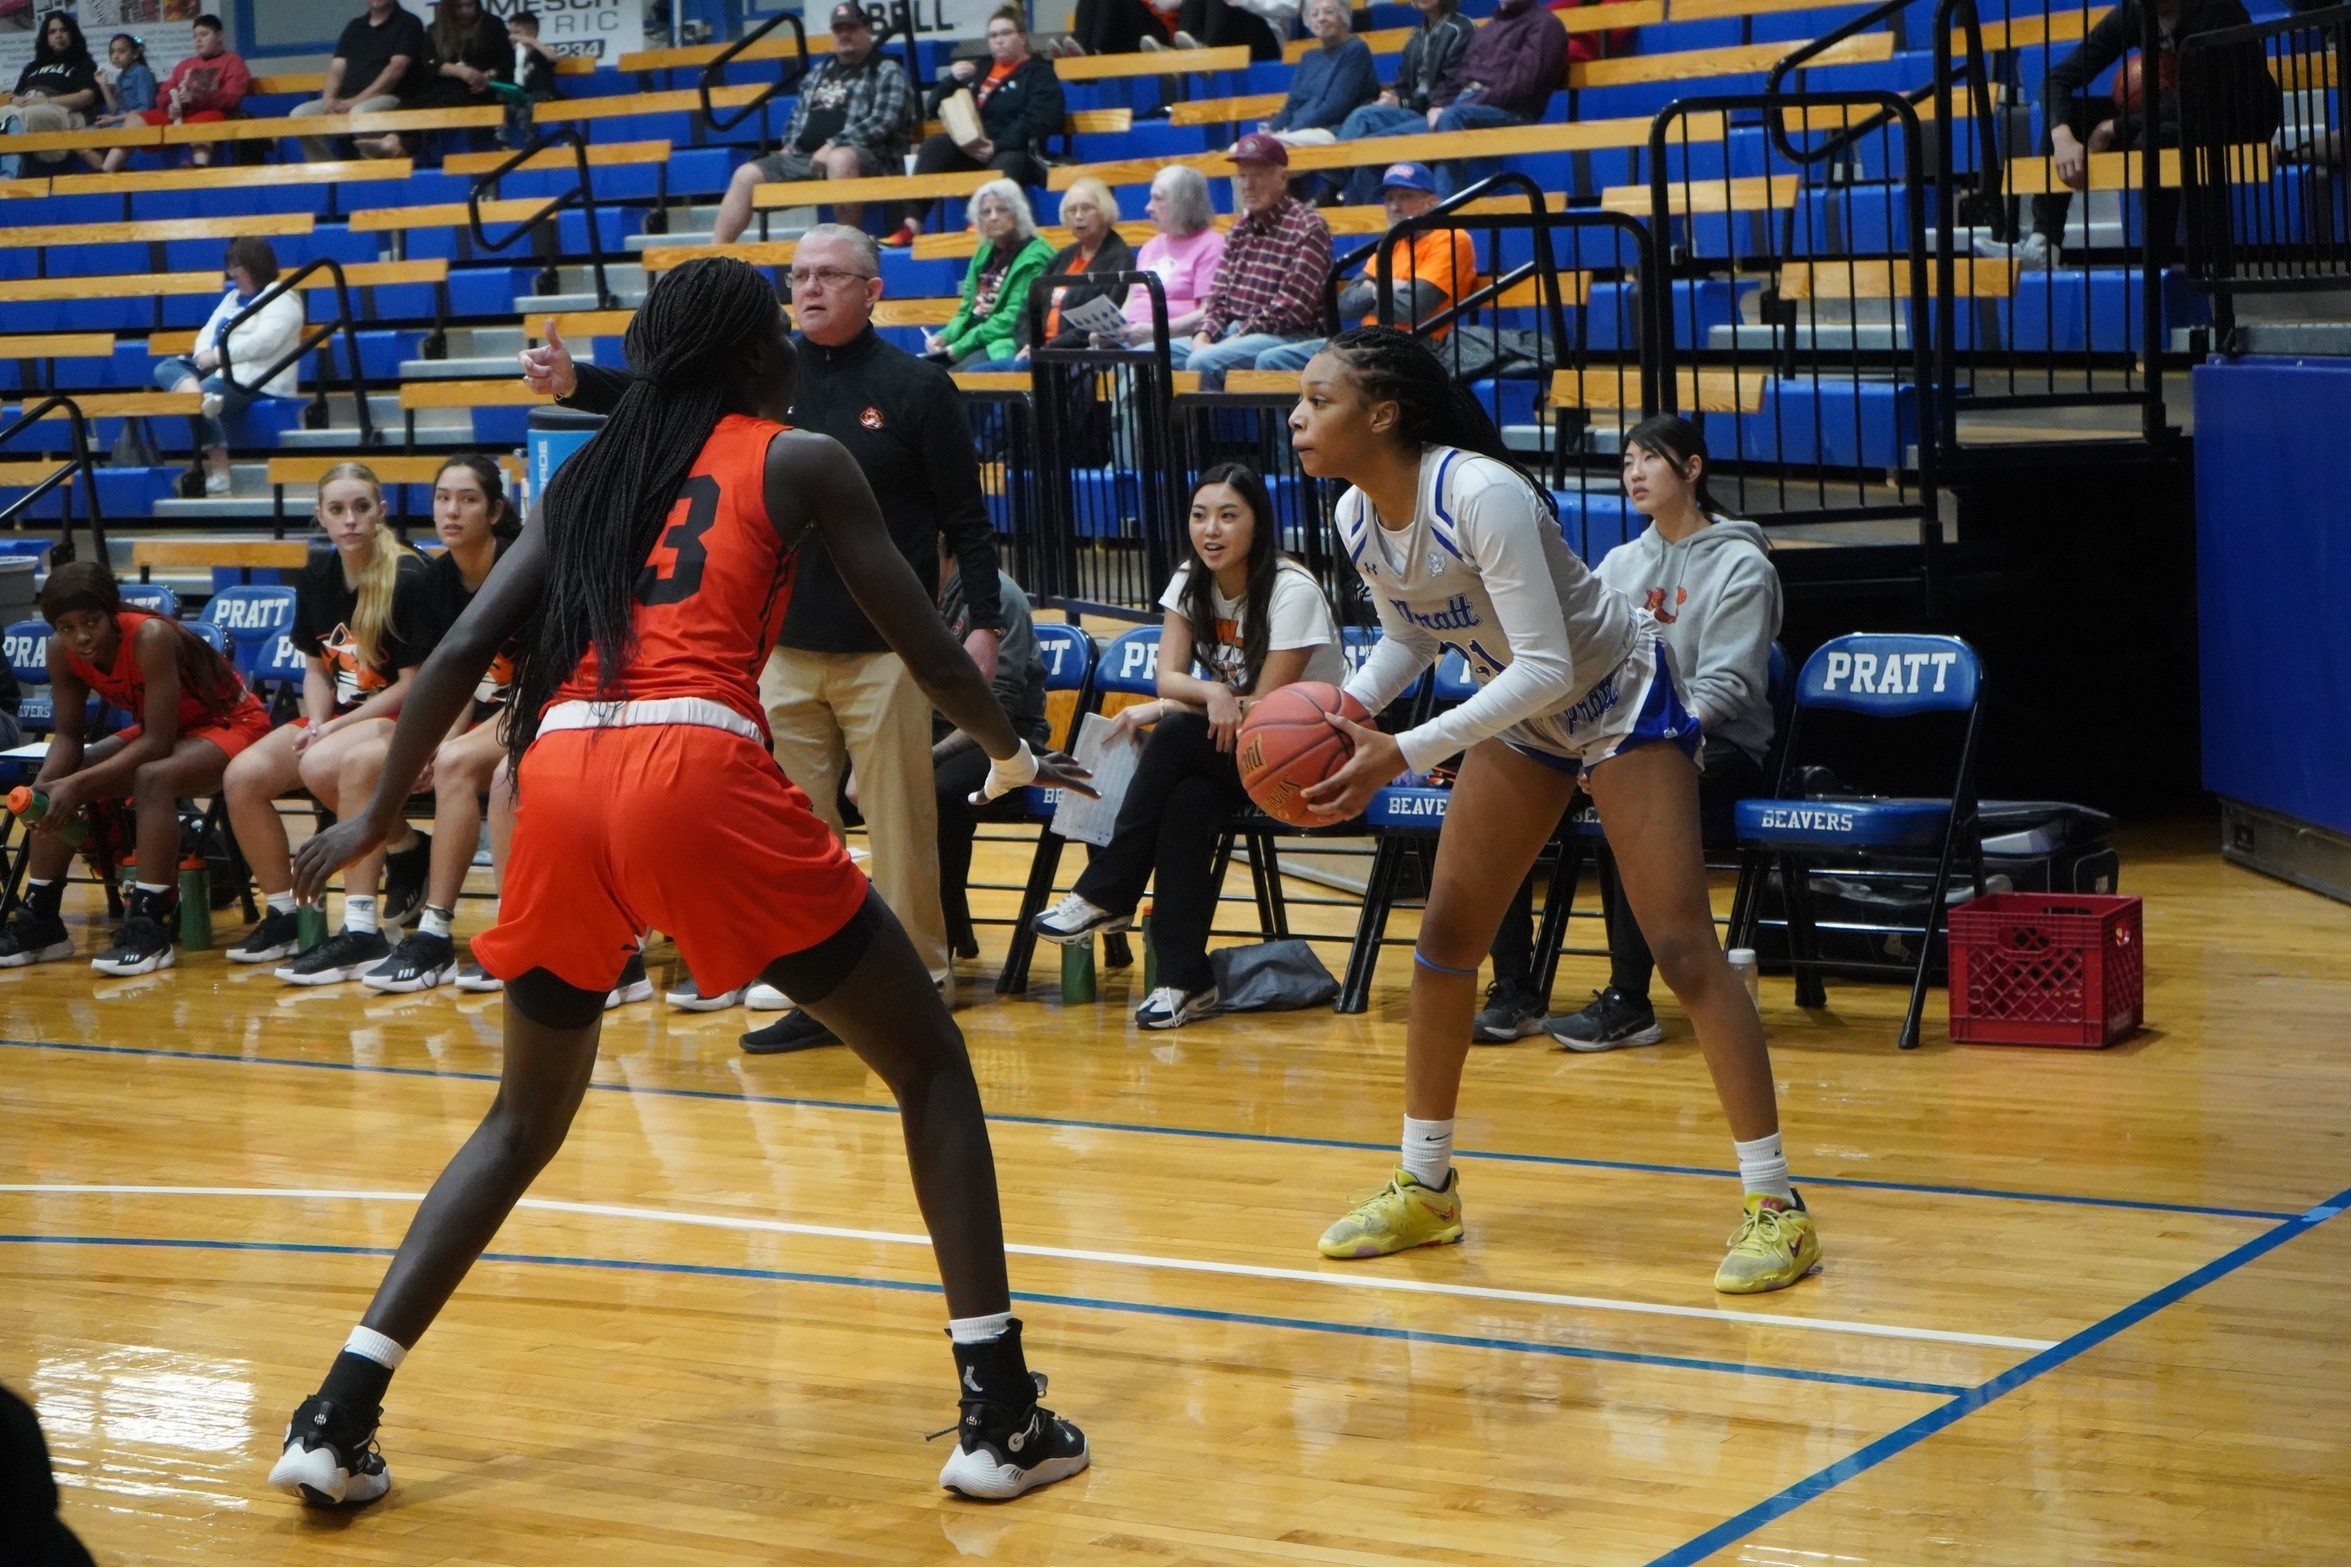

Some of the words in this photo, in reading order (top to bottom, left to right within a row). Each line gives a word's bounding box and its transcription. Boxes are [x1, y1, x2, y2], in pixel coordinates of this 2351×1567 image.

[541, 11, 619, 34] RIC
[633, 474, 721, 607] 3
[213, 598, 290, 628] PRATT
[2, 636, 49, 668] PRA
[1823, 651, 1956, 694] PRATT
[18, 705, 50, 718] AVERS
[1388, 797, 1446, 816] BEAVE
[1761, 809, 1853, 831] BEAVERS
